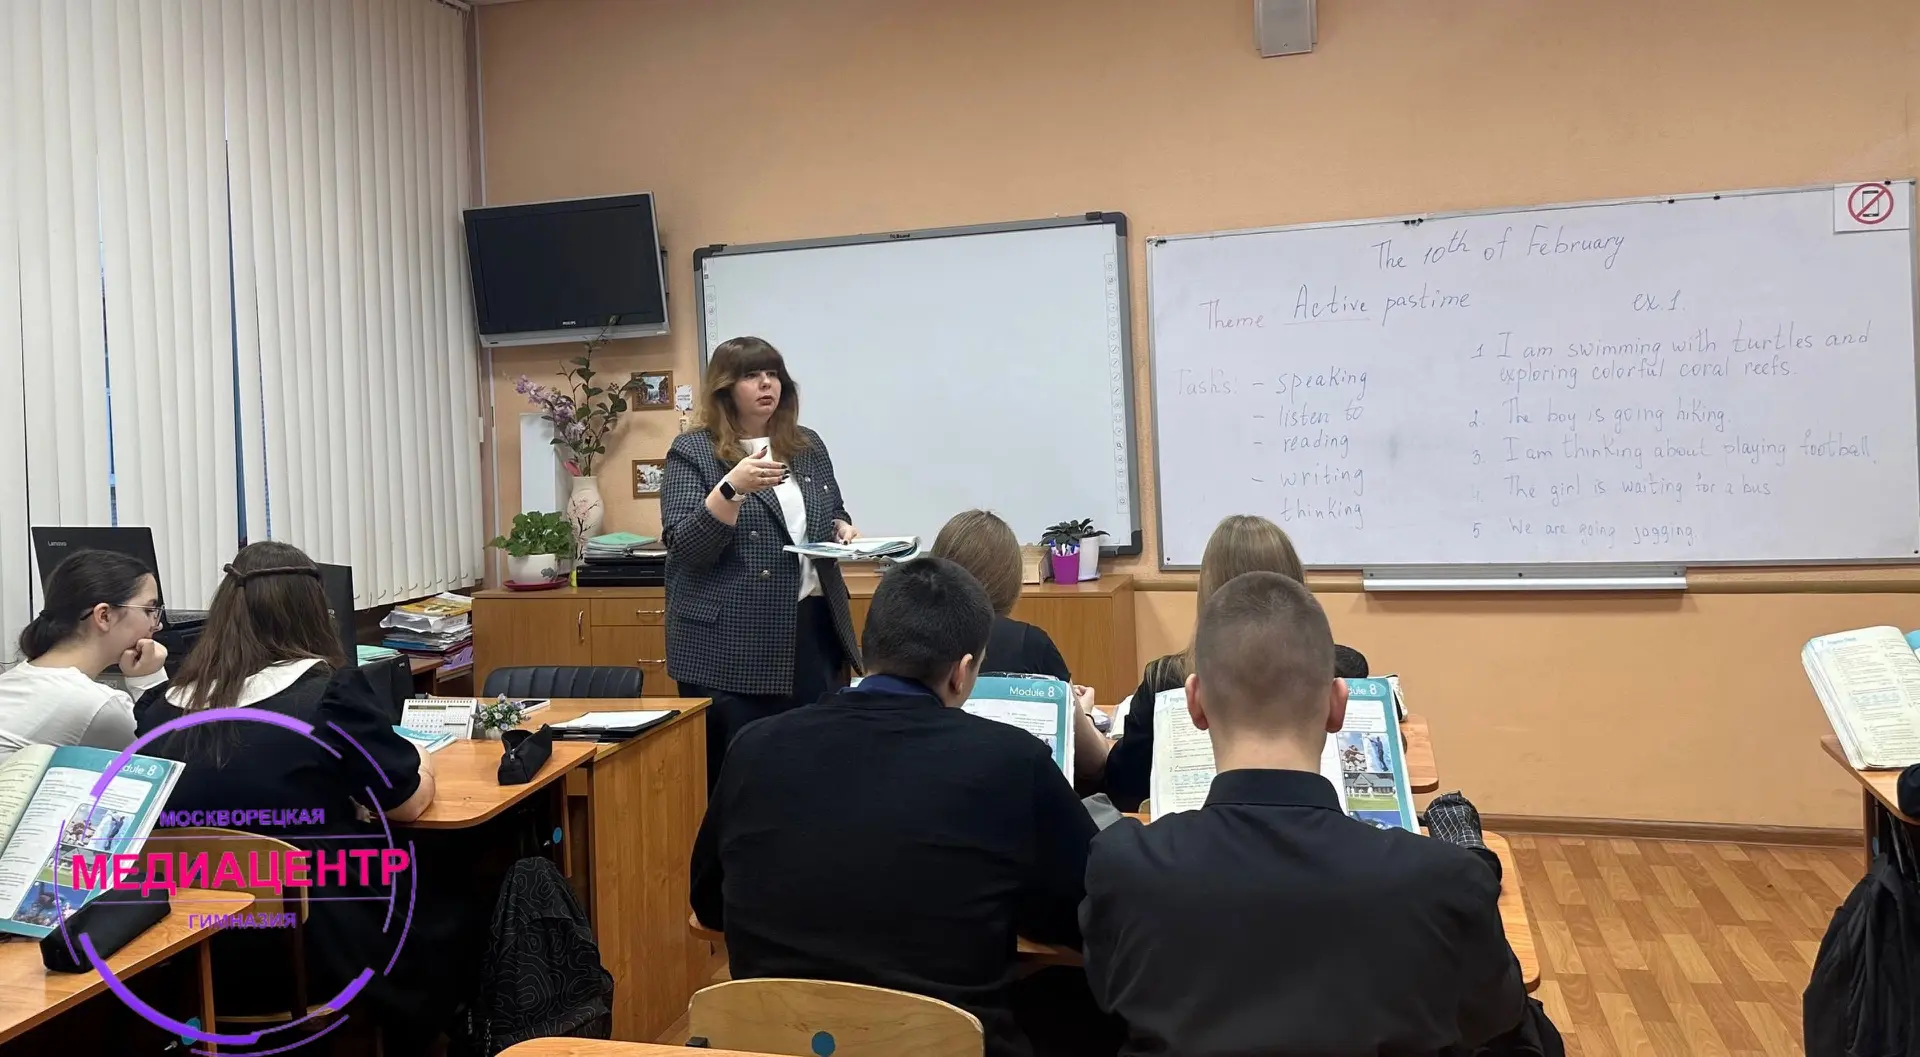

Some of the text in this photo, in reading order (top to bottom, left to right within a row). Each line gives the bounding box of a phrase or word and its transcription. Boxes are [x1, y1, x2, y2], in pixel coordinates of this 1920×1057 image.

[1371, 224, 1626, 271] The 10th of February
[1199, 282, 1472, 331] Theme Active pastime
[1498, 331, 1512, 358] I
[1522, 344, 1553, 358] am
[1567, 338, 1661, 368] swimming
[1671, 327, 1718, 354] with
[1732, 319, 1813, 353] turtles
[1824, 320, 1872, 345] and
[1275, 366, 1368, 404] speaking
[1499, 360, 1579, 394] exploring
[1591, 356, 1664, 380] colorful
[1679, 356, 1730, 378] coral
[1278, 403, 1330, 428] listen
[1344, 401, 1364, 422] to
[1502, 396, 1533, 425] The
[1547, 397, 1576, 432] boy
[1588, 408, 1605, 422] is
[1613, 407, 1665, 435] going
[1283, 429, 1349, 459] reading
[1502, 435, 1520, 462] I
[1526, 449, 1553, 460] am
[1562, 433, 1643, 469] thinking
[1654, 438, 1712, 458] about
[1723, 435, 1788, 467] playing
[1280, 463, 1364, 496] writing
[1504, 475, 1536, 498] The
[1551, 473, 1580, 507] girl
[1594, 479, 1606, 494] is
[1621, 472, 1683, 503] waiting
[1695, 472, 1716, 493] for
[1724, 482, 1735, 495] a
[1280, 497, 1364, 531] thinking
[1508, 517, 1532, 535] We
[1545, 524, 1566, 535] are
[1578, 522, 1616, 549] going
[1009, 686, 1055, 698] Module 8
[1369, 683, 1377, 695] 8
[146, 764, 157, 776] 8
